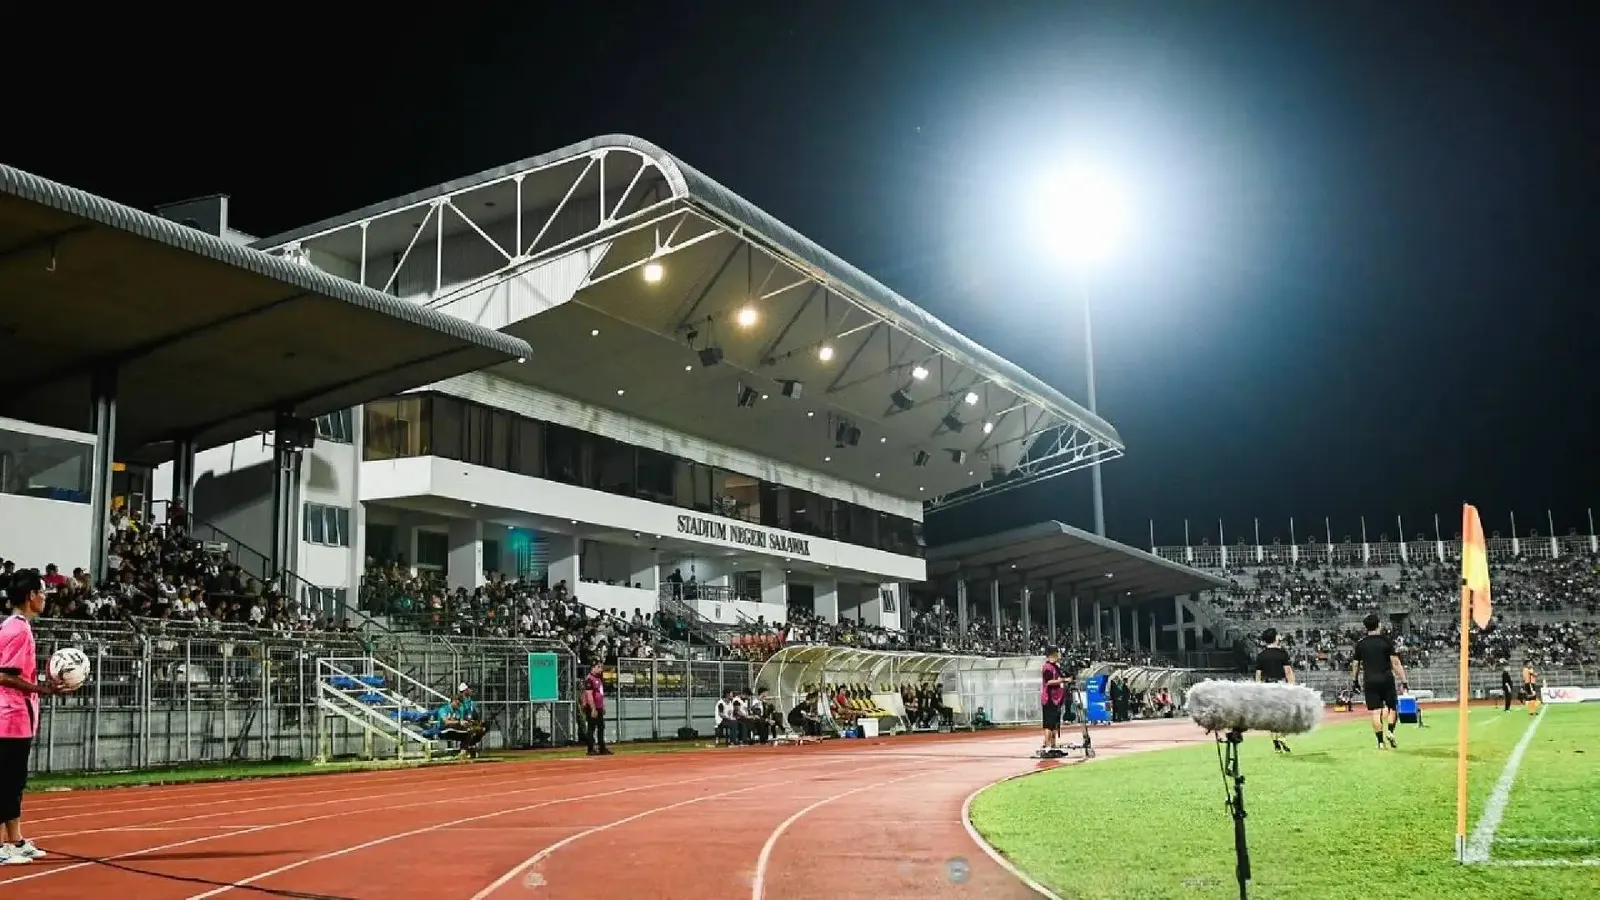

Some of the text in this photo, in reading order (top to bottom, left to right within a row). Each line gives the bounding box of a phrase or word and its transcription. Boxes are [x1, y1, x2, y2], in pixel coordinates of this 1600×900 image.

[677, 515, 811, 556] STADIUM NEGERI SARAWAK
